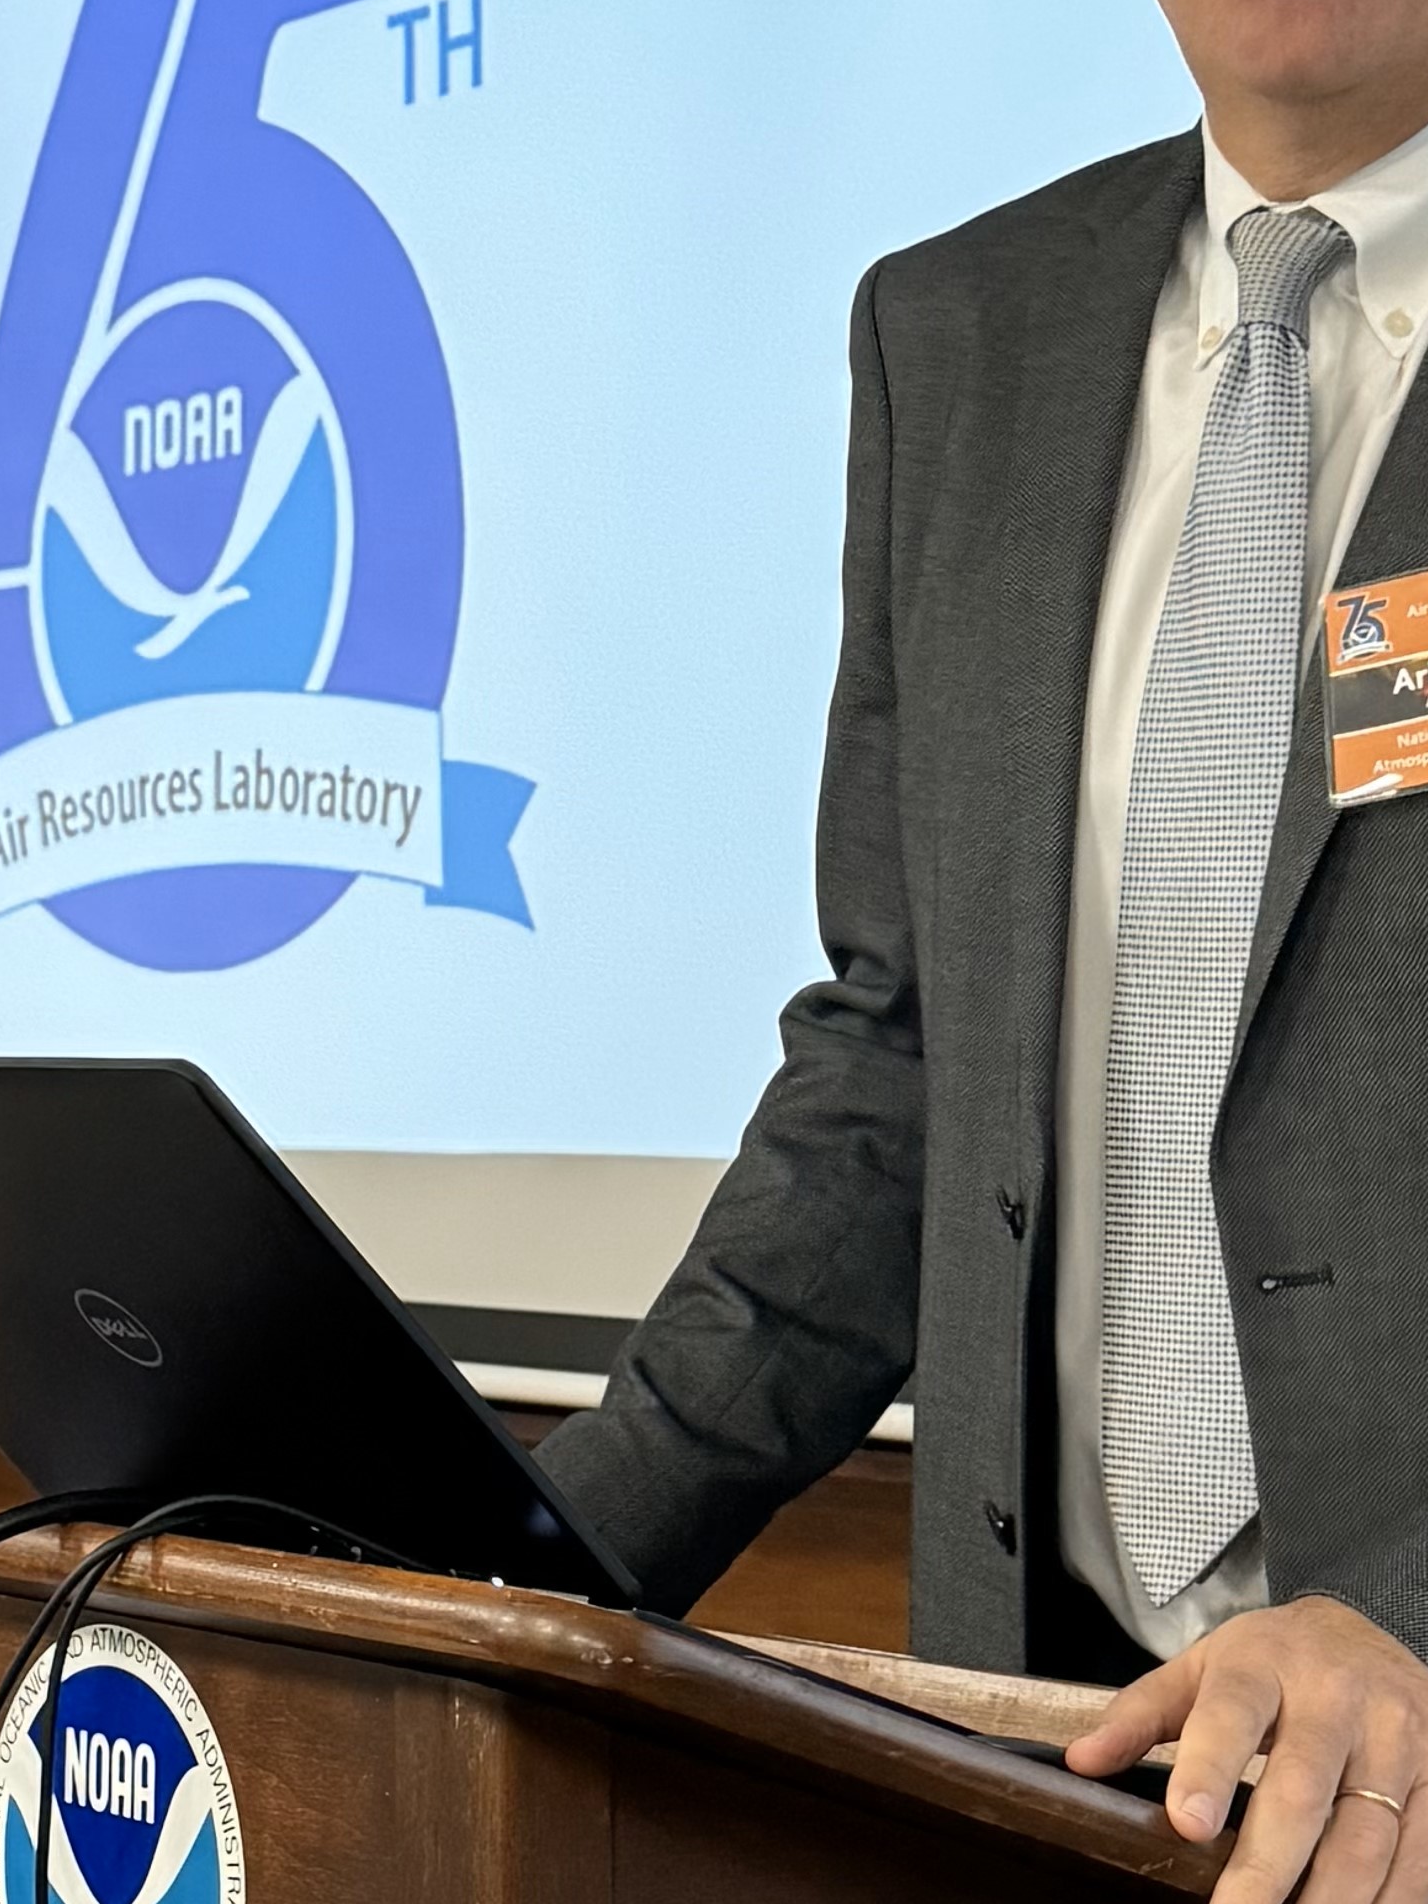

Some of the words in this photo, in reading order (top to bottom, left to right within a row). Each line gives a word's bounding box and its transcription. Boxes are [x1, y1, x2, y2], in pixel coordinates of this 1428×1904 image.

[123, 384, 243, 478] NOAA
[37, 767, 203, 848] Resources
[213, 748, 422, 849] Laboratory
[90, 1627, 199, 1723] ATMOSPHERIC
[65, 1726, 157, 1825] NOAA
